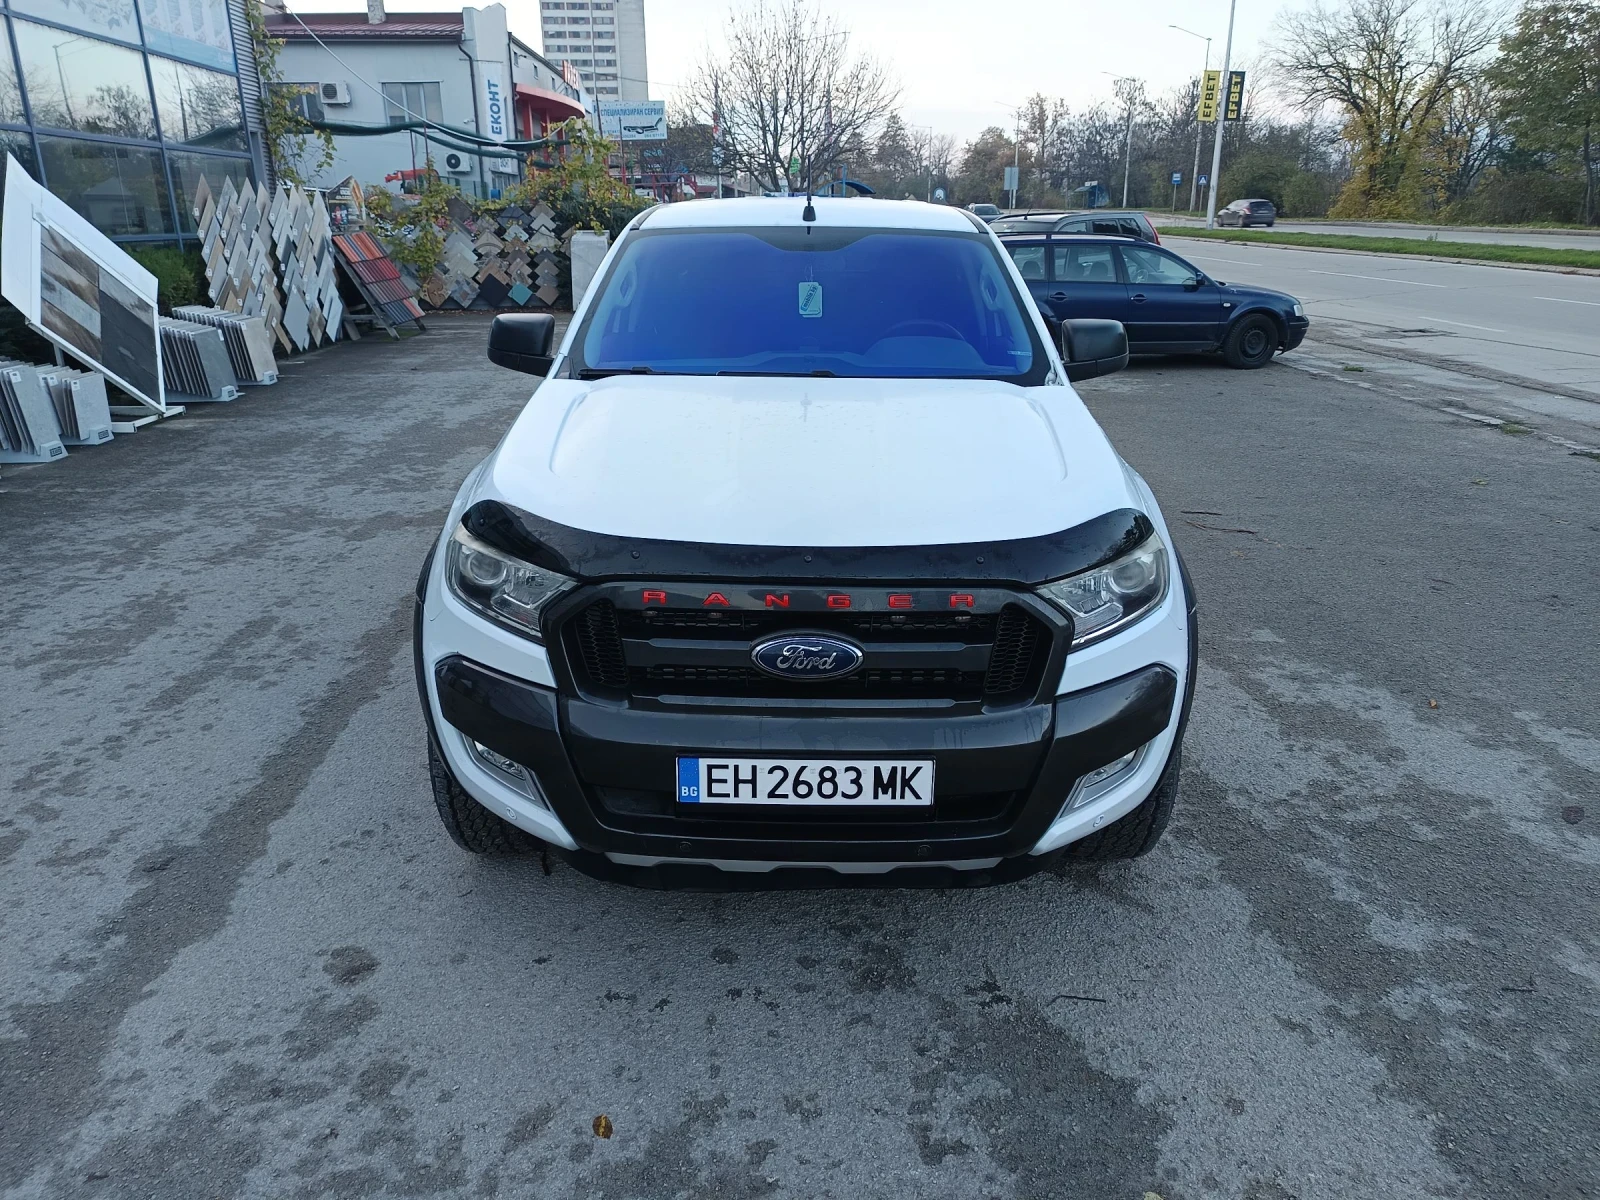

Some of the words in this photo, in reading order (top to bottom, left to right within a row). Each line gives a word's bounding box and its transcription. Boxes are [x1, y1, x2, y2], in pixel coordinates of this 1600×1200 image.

[487, 79, 502, 135] ЕКОНТ
[1202, 74, 1217, 118] EFBET
[1227, 74, 1241, 119] EFBET
[601, 107, 643, 117] СПЕЦИАЛИЗИРАН
[644, 107, 664, 116] СЕРВИЗ
[642, 590, 975, 609] RANGER
[776, 644, 836, 670] Ford
[682, 786, 698, 797] BG
